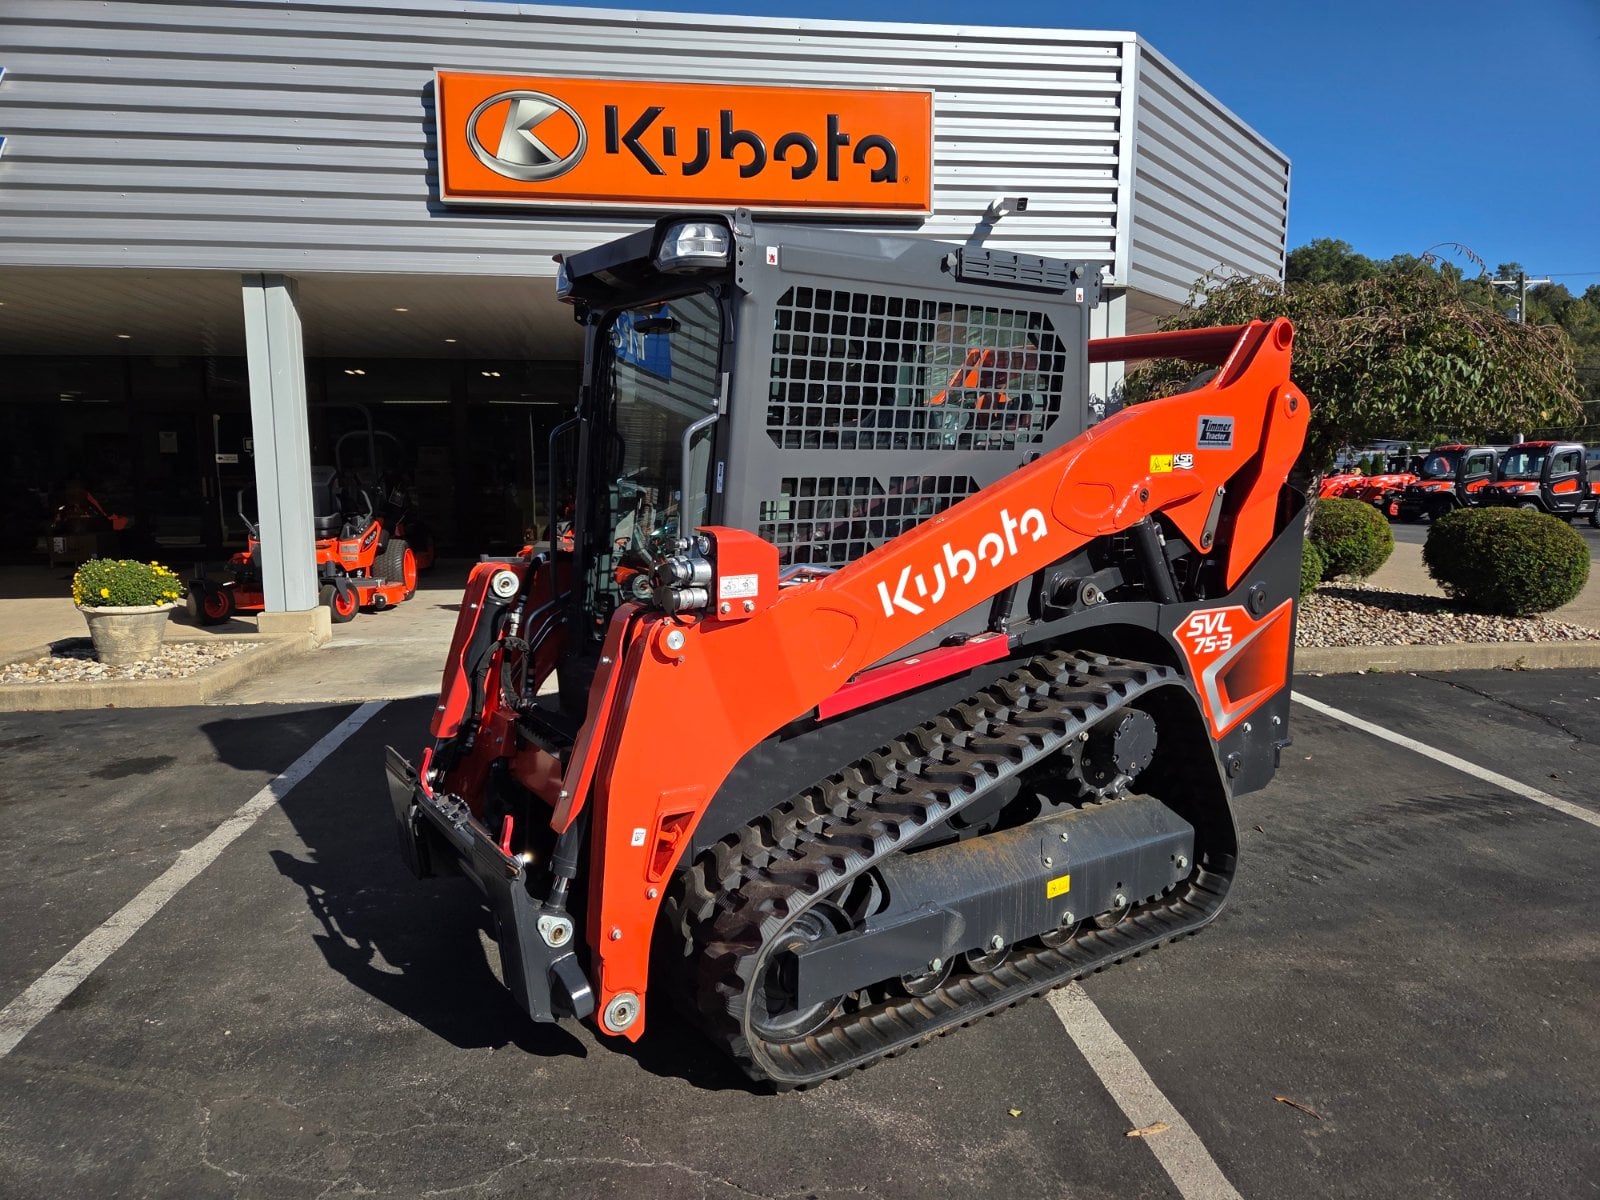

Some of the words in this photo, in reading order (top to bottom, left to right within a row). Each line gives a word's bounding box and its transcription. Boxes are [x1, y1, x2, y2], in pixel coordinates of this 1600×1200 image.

[604, 104, 898, 184] Kubota
[1200, 419, 1232, 438] Zimmer
[1206, 432, 1227, 440] Tractor
[877, 508, 1048, 618] Kubota
[1186, 612, 1232, 638] SVL
[1193, 634, 1233, 655] 75-3
